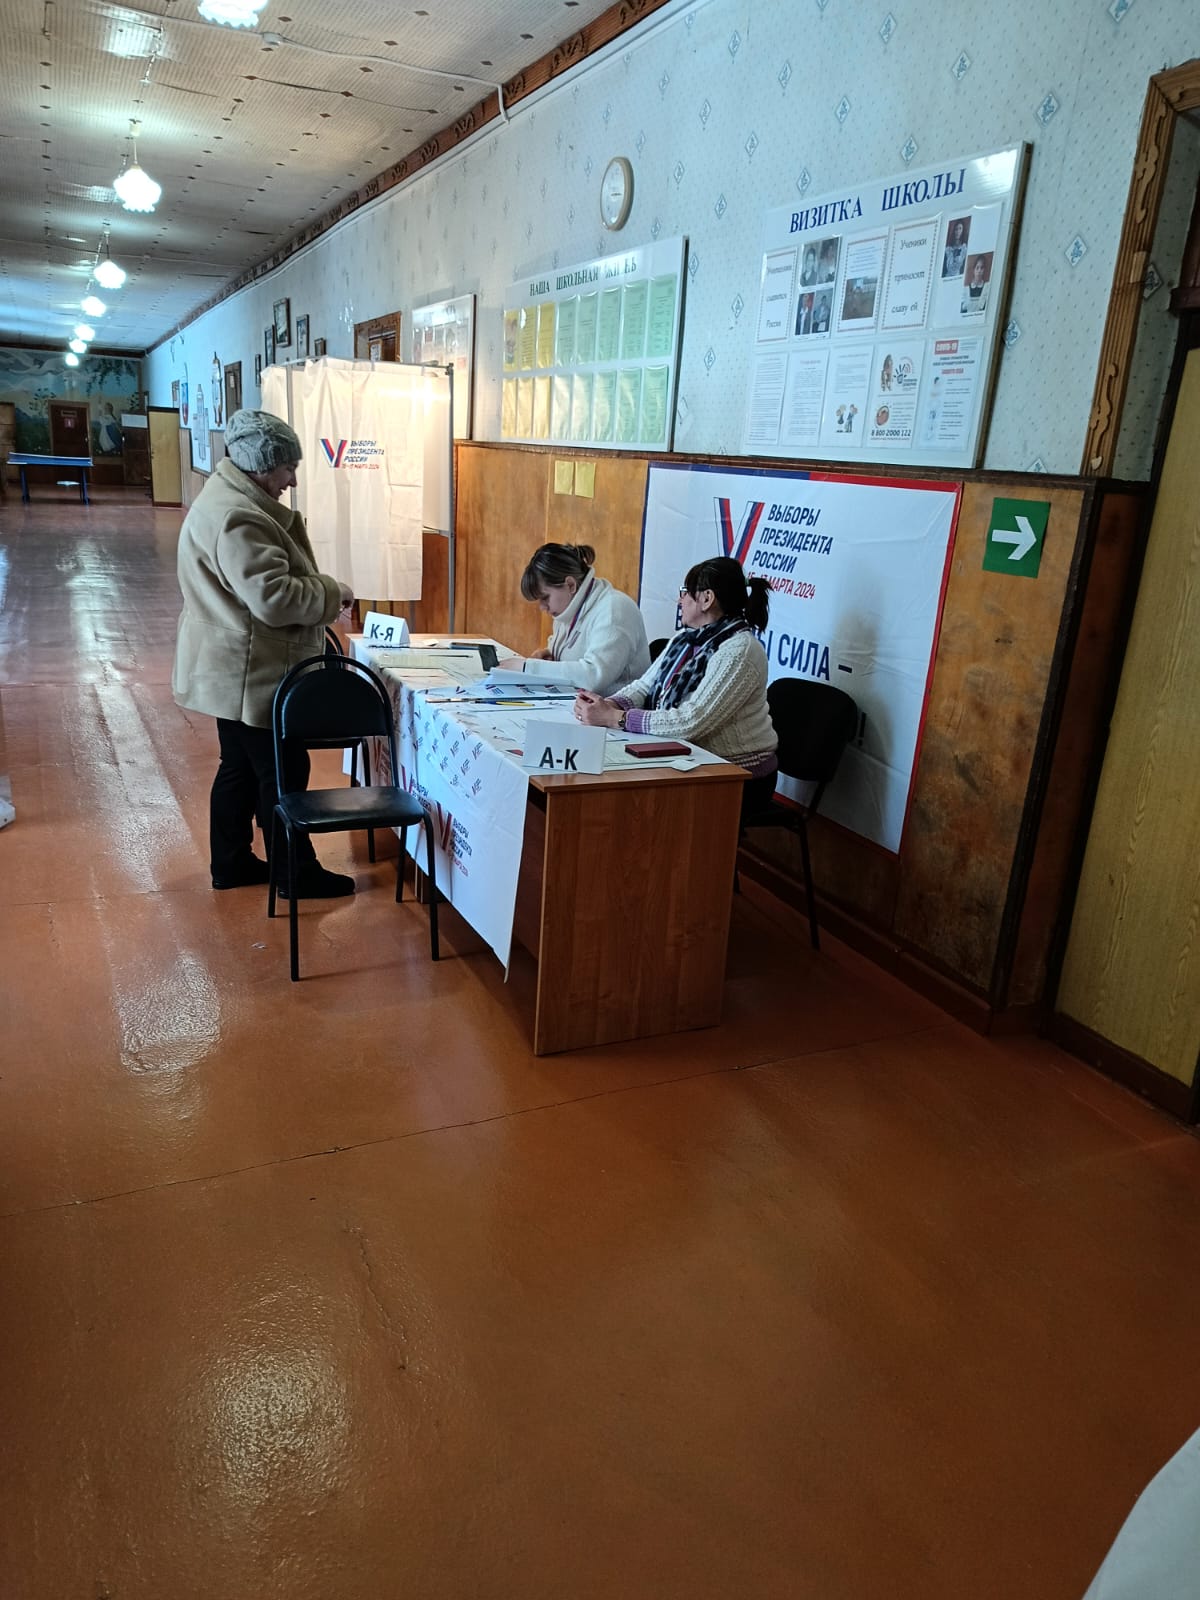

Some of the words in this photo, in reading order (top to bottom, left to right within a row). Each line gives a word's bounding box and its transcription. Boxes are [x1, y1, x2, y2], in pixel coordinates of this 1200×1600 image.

[789, 196, 862, 233] ВИЗИТКА
[881, 168, 967, 211] ШКОЛЫ
[530, 280, 550, 296] НАША
[556, 265, 599, 290] ШКОЛЬНАЯ
[768, 503, 821, 527] ВЫБОРЫ
[760, 527, 834, 555] ПРЕЗИДЕНТА
[752, 550, 798, 574] РОССИИ
[794, 582, 816, 600] 2024
[370, 623, 394, 642] К-Я
[777, 633, 830, 681] СИЛА
[539, 746, 579, 771] А-К
